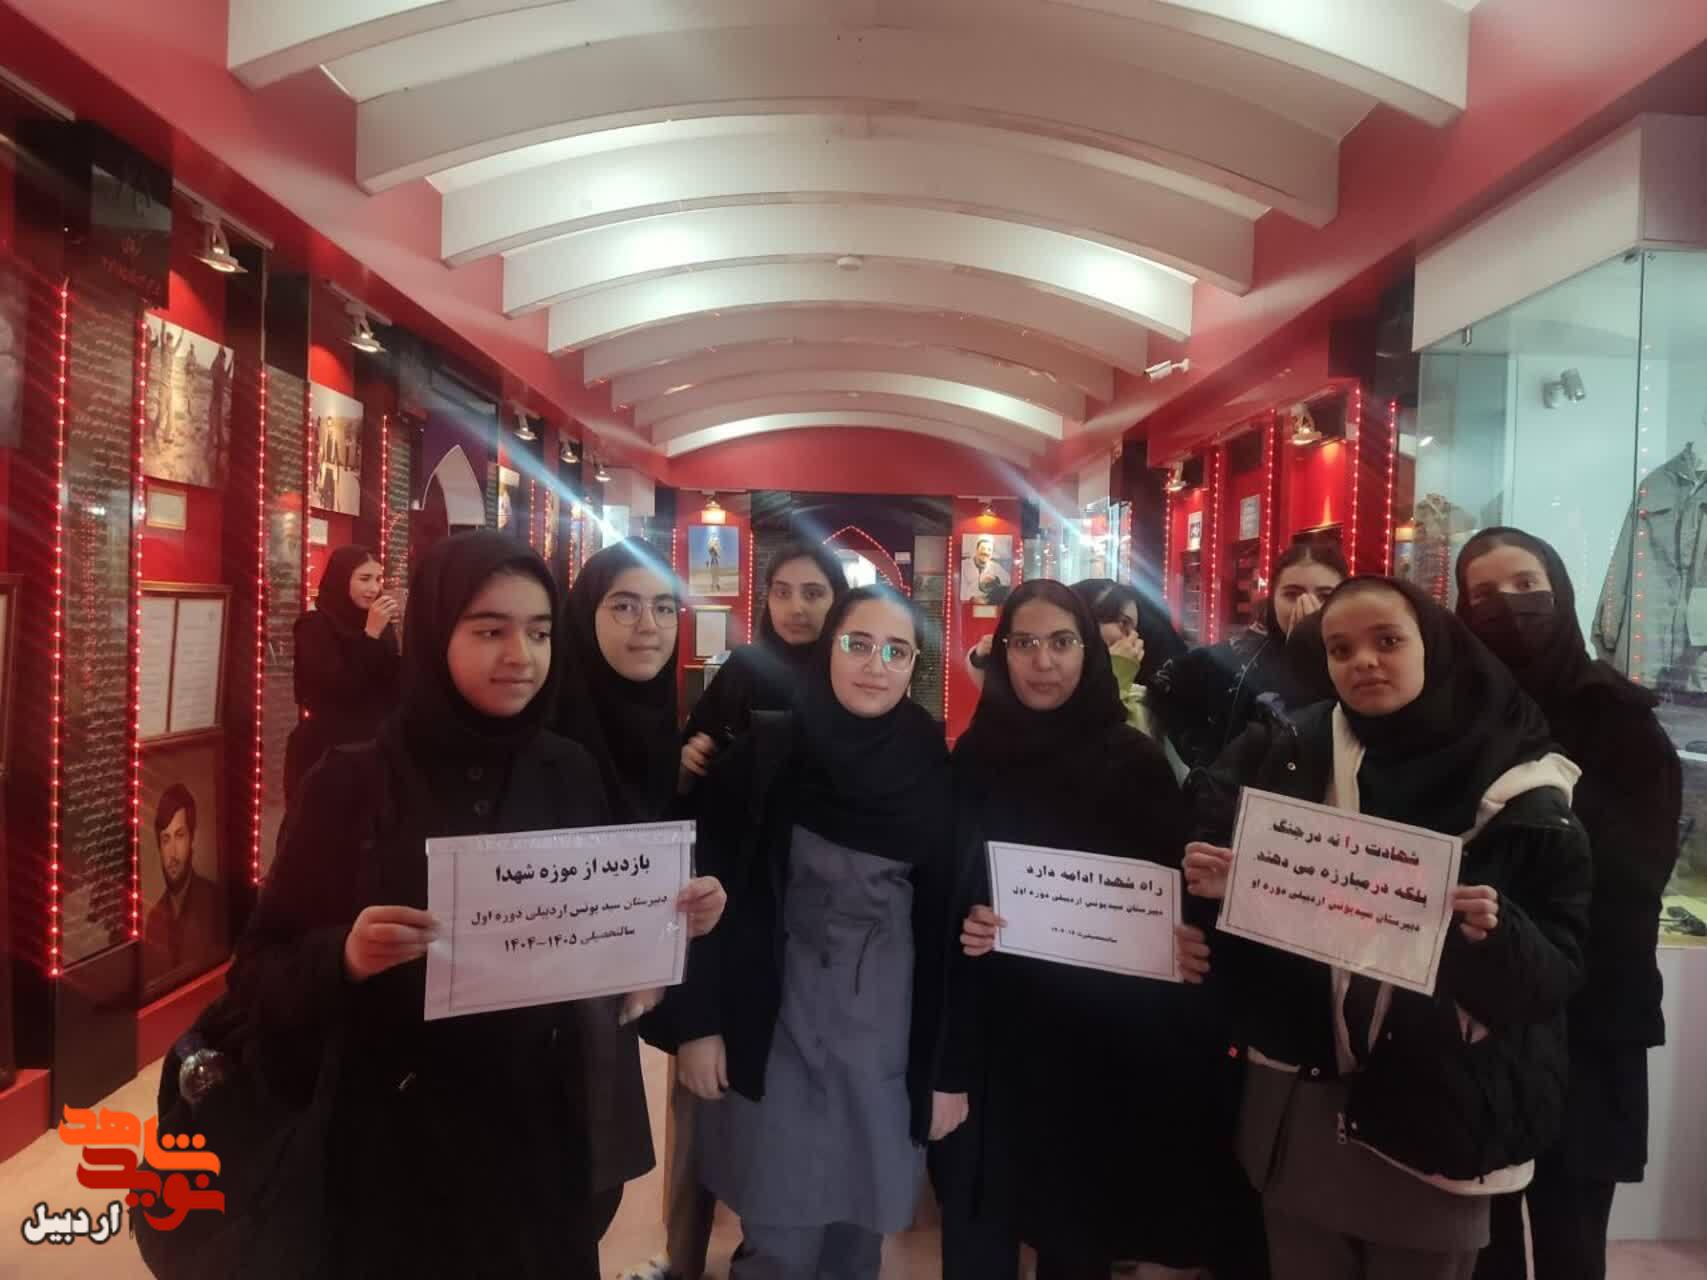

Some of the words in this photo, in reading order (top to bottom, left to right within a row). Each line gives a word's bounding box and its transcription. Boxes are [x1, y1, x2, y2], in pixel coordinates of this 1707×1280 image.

[1327, 832, 1340, 848] نه
[1344, 835, 1359, 855] را
[1256, 850, 1288, 868] دهند
[1364, 844, 1419, 866] شهادت
[495, 863, 535, 885] شهدا
[540, 864, 577, 883] موزه
[582, 857, 597, 881] از
[602, 853, 650, 877] بازدید
[1026, 865, 1055, 878] دارد
[1293, 865, 1315, 876] می
[1060, 868, 1093, 883] ادامه
[1099, 873, 1135, 889] شهدا
[1140, 879, 1163, 896] راه
[1394, 886, 1427, 909] بلکه
[472, 910, 491, 926] اول
[496, 910, 523, 924] دوره
[526, 903, 567, 921] اردبیلی
